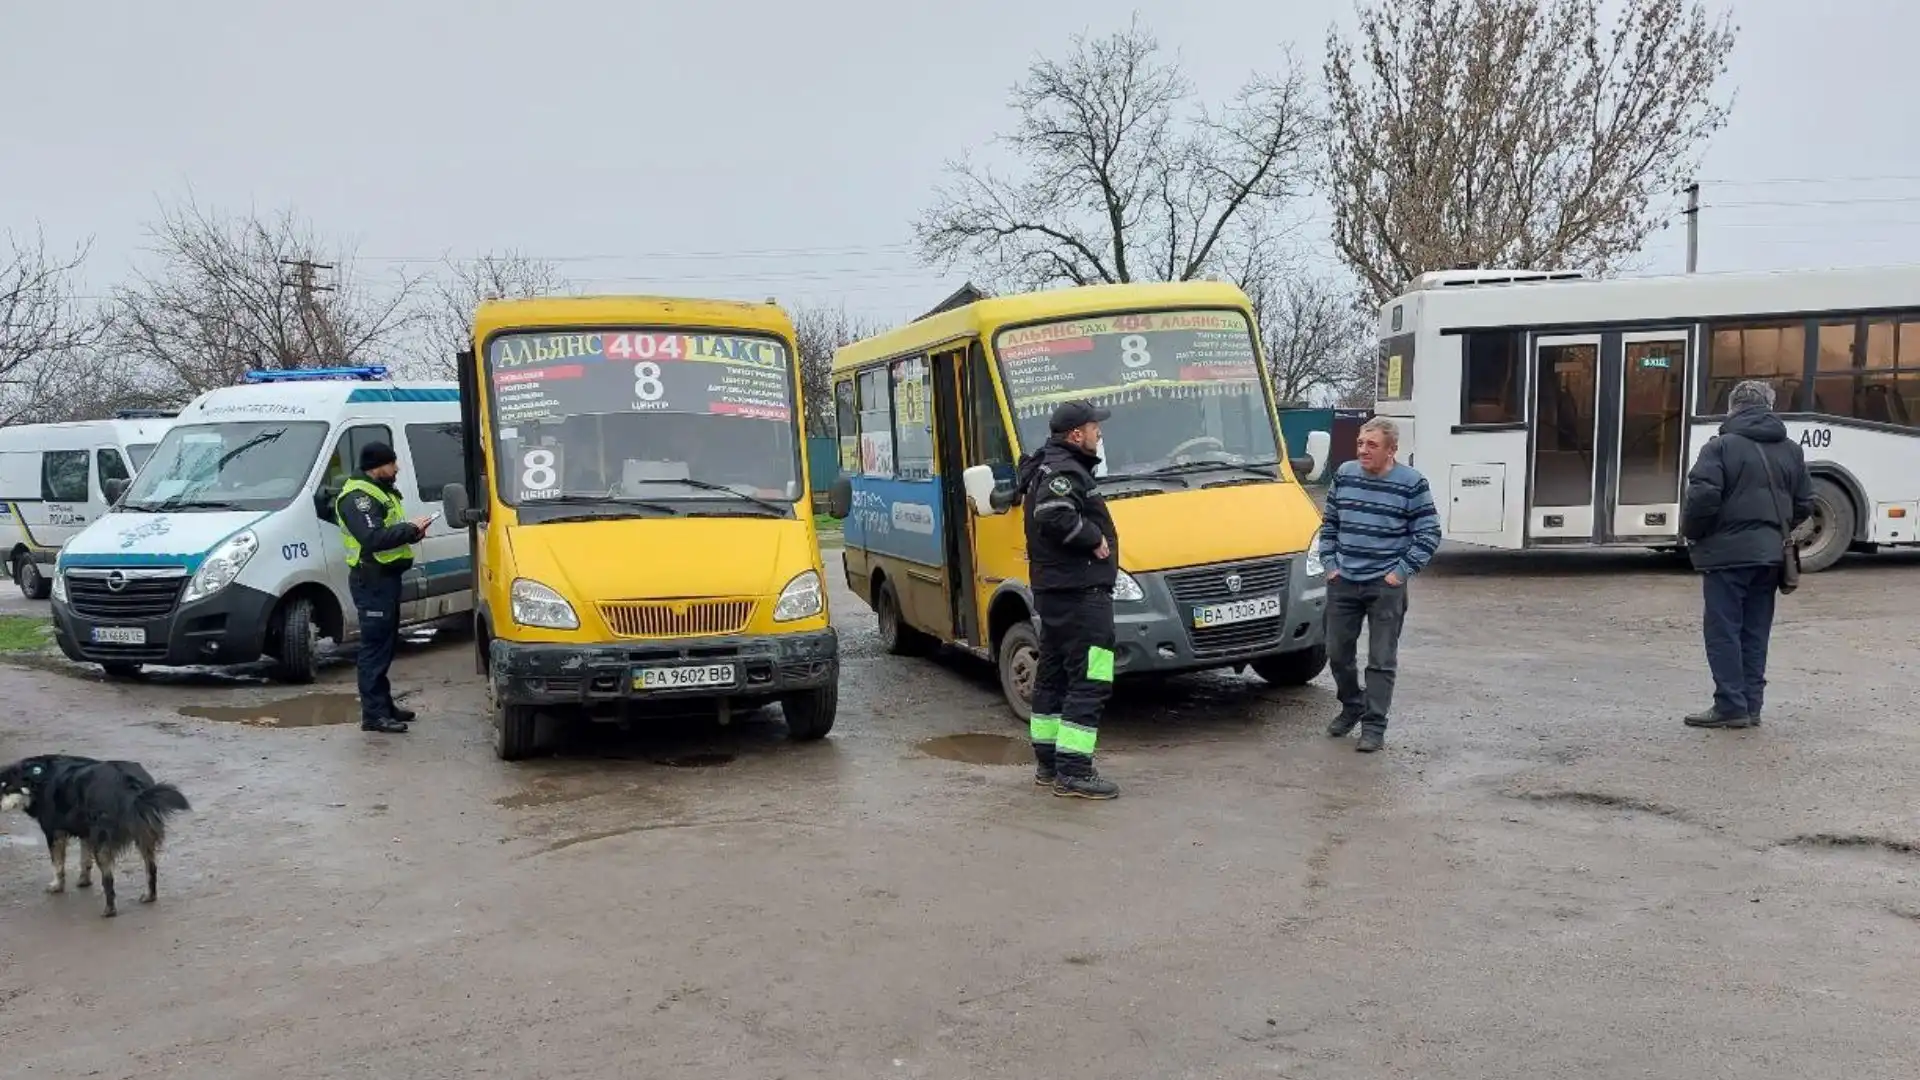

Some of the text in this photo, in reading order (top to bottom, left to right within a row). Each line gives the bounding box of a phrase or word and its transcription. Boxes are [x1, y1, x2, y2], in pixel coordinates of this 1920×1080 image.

[1008, 322, 1077, 346] АЛЬЯНС
[1079, 322, 1107, 336] TAXI
[1112, 315, 1153, 330] 404
[1160, 315, 1220, 329] АЛЬЯНС
[499, 334, 602, 367] АЛЬЯНС
[609, 334, 682, 359] 404
[1121, 334, 1151, 368] 8
[634, 361, 664, 401] 8
[631, 401, 670, 410] ЦЕНТР
[1800, 429, 1831, 448] A09
[522, 449, 556, 490] 8
[520, 488, 561, 500] ЦЕНТР
[282, 542, 309, 561] 078
[1204, 608, 1223, 623] BA
[644, 666, 732, 685] BA 9602 BB
